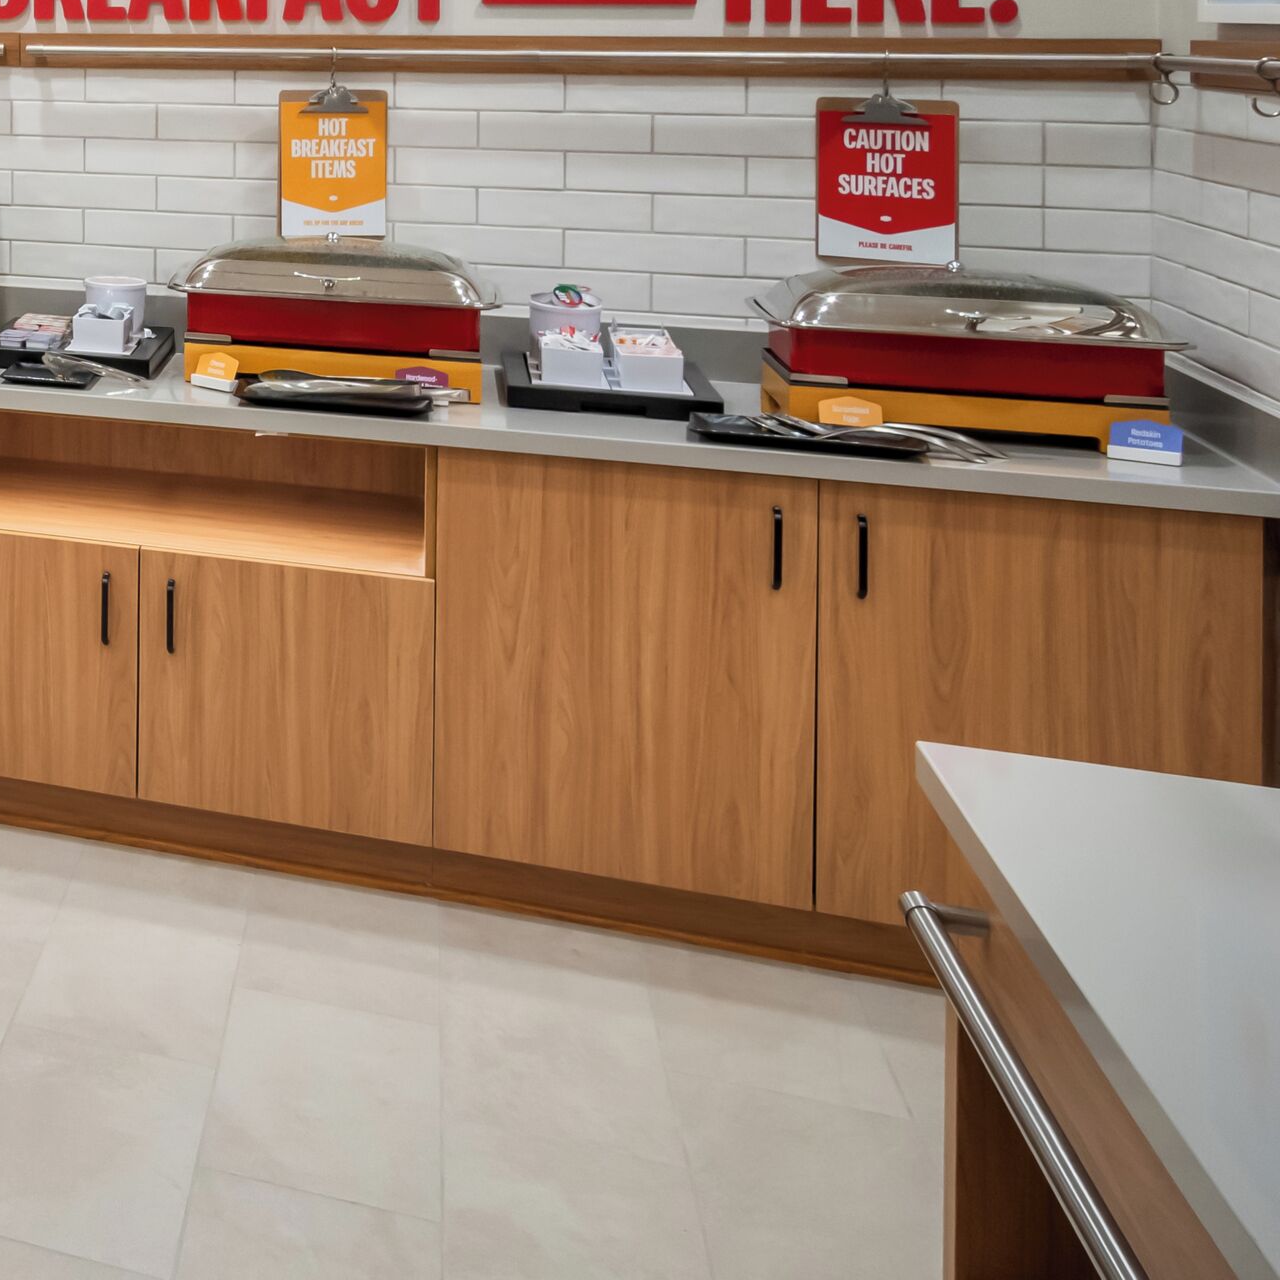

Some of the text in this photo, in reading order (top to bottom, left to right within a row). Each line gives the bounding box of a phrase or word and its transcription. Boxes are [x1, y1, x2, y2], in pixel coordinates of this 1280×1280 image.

[318, 118, 348, 136] HOT
[291, 139, 376, 158] BREAKFAST
[843, 128, 930, 152] CAUTION
[311, 160, 357, 179] ITEMS
[866, 152, 906, 174] HOT
[838, 174, 936, 200] SURFACES
[858, 241, 878, 249] PLEASE
[1130, 427, 1161, 439] Redskin
